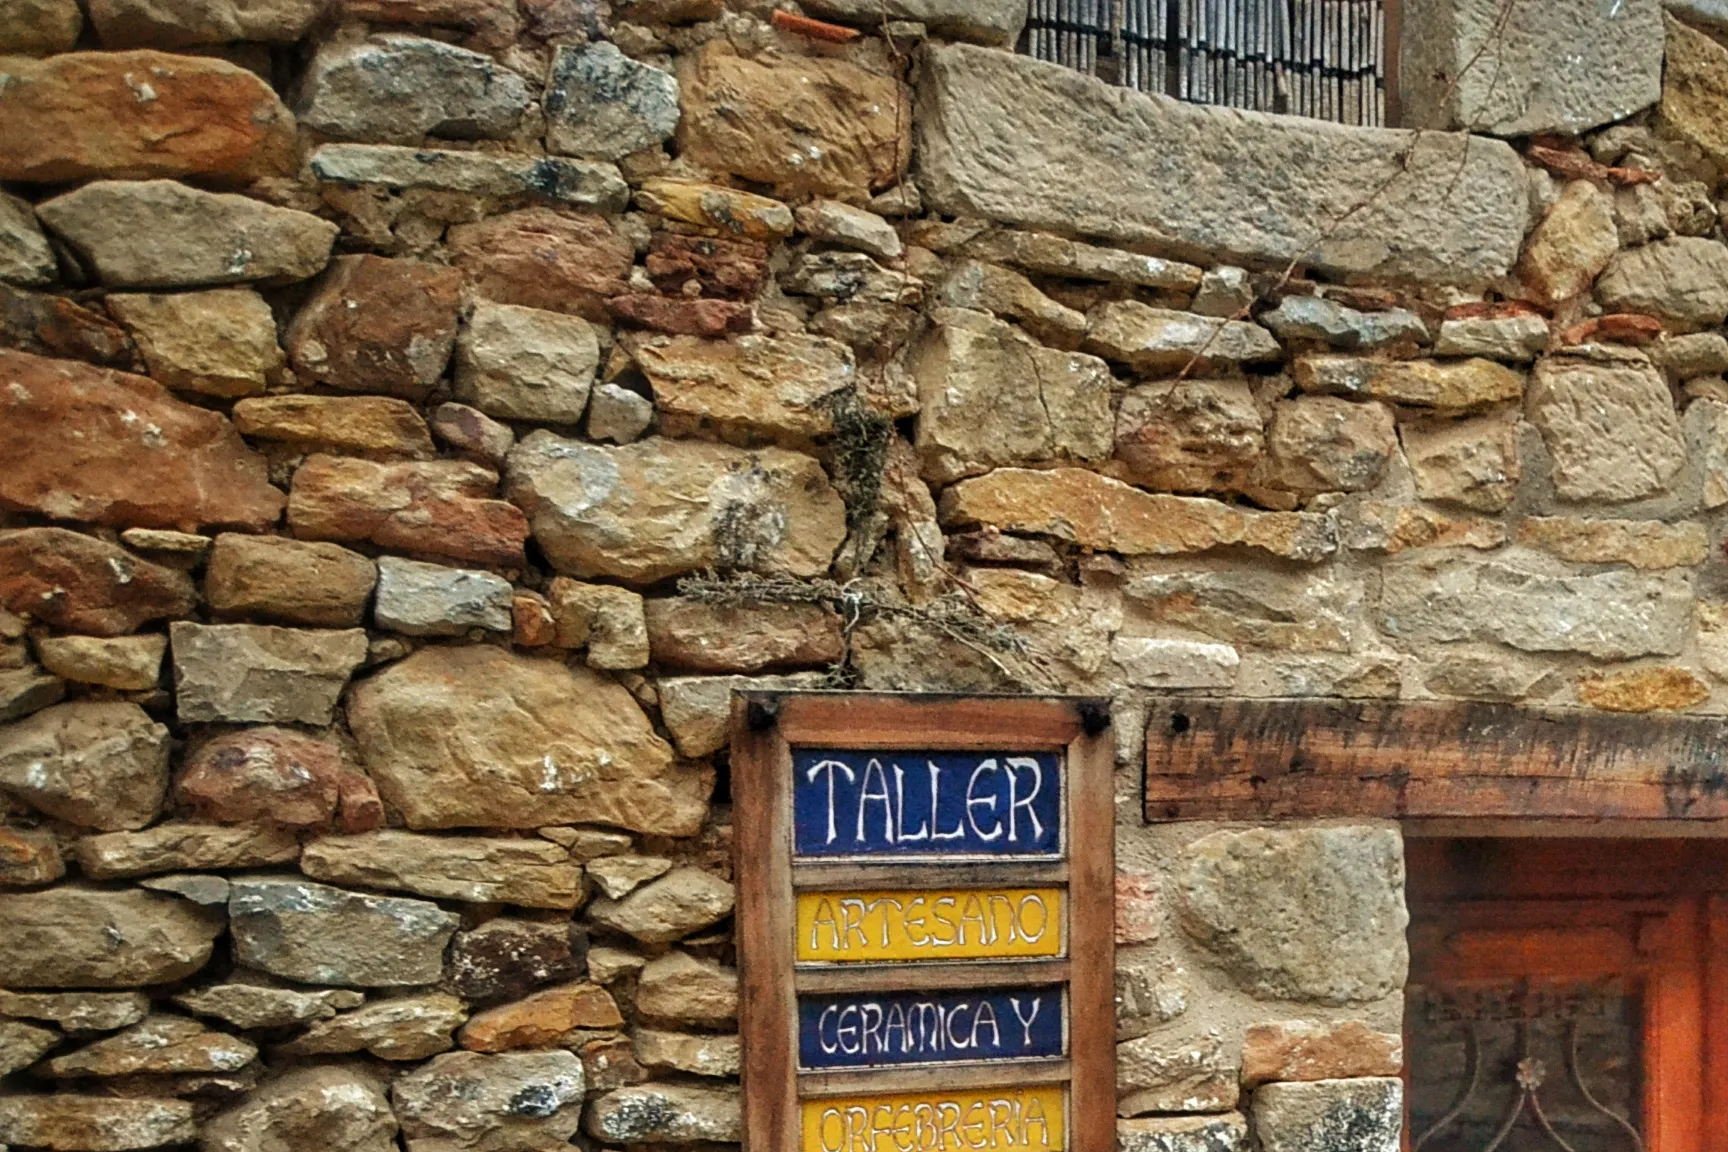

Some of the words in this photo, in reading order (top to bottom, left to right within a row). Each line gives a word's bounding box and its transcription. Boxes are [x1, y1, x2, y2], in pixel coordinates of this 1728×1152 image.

[806, 757, 1044, 845] TALLER
[811, 893, 1047, 950] ARTESANO
[818, 1000, 1000, 1055] CERAMICA
[1010, 997, 1041, 1047] Y
